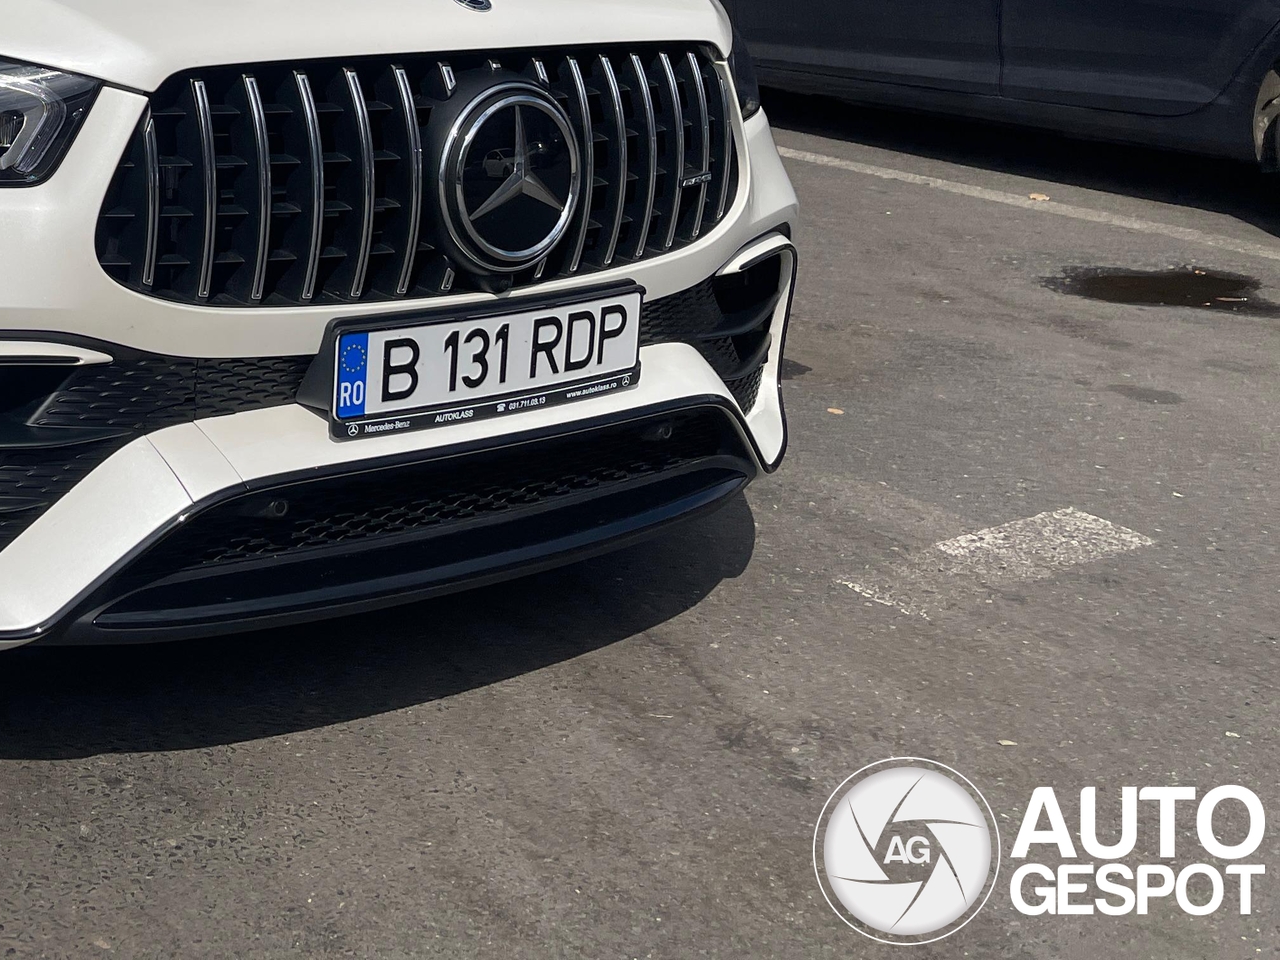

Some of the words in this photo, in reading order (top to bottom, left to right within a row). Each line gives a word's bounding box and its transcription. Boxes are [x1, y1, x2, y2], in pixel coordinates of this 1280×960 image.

[381, 337, 419, 402] B
[444, 323, 510, 392] 131
[530, 304, 627, 379] RDP
[339, 380, 364, 407] RO
[364, 420, 410, 433] Mercedes-Benz
[435, 410, 474, 423] AUTOKLASS
[566, 381, 617, 398] www.autoklass.ro
